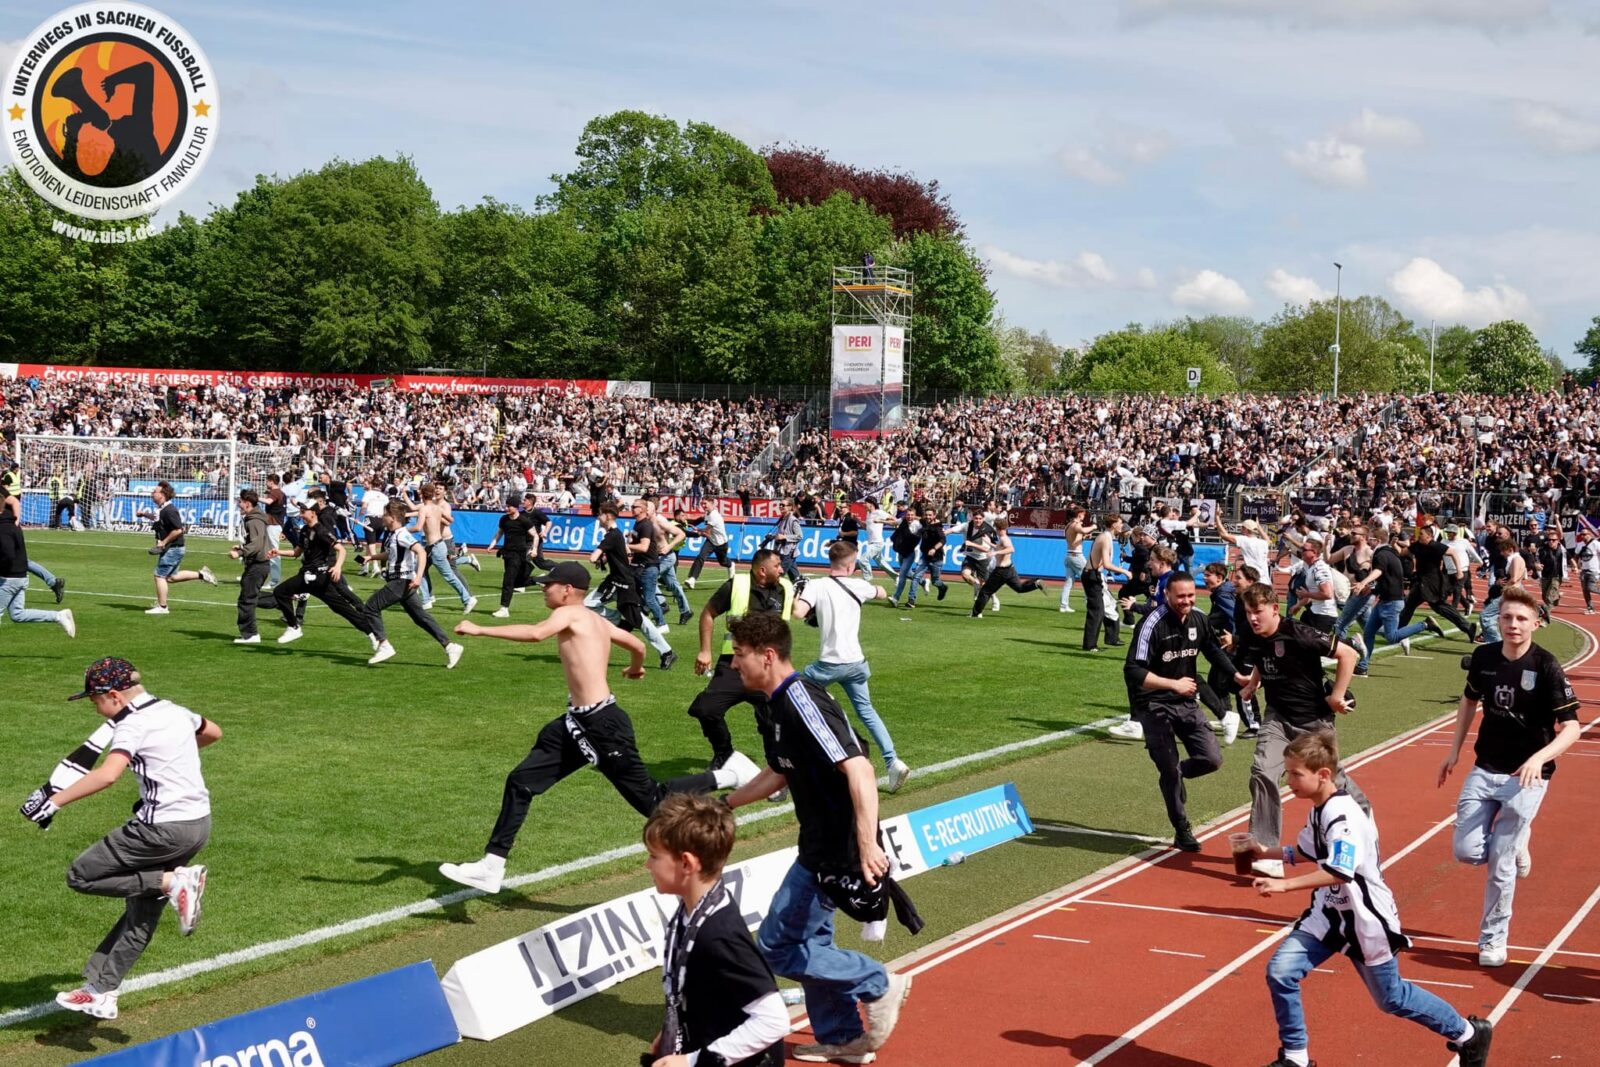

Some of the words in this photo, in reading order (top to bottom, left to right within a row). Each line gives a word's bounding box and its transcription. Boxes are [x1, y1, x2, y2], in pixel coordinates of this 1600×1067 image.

[848, 335, 872, 348] PERI
[1188, 370, 1197, 381] D
[921, 799, 1019, 853] E-RECRUITING
